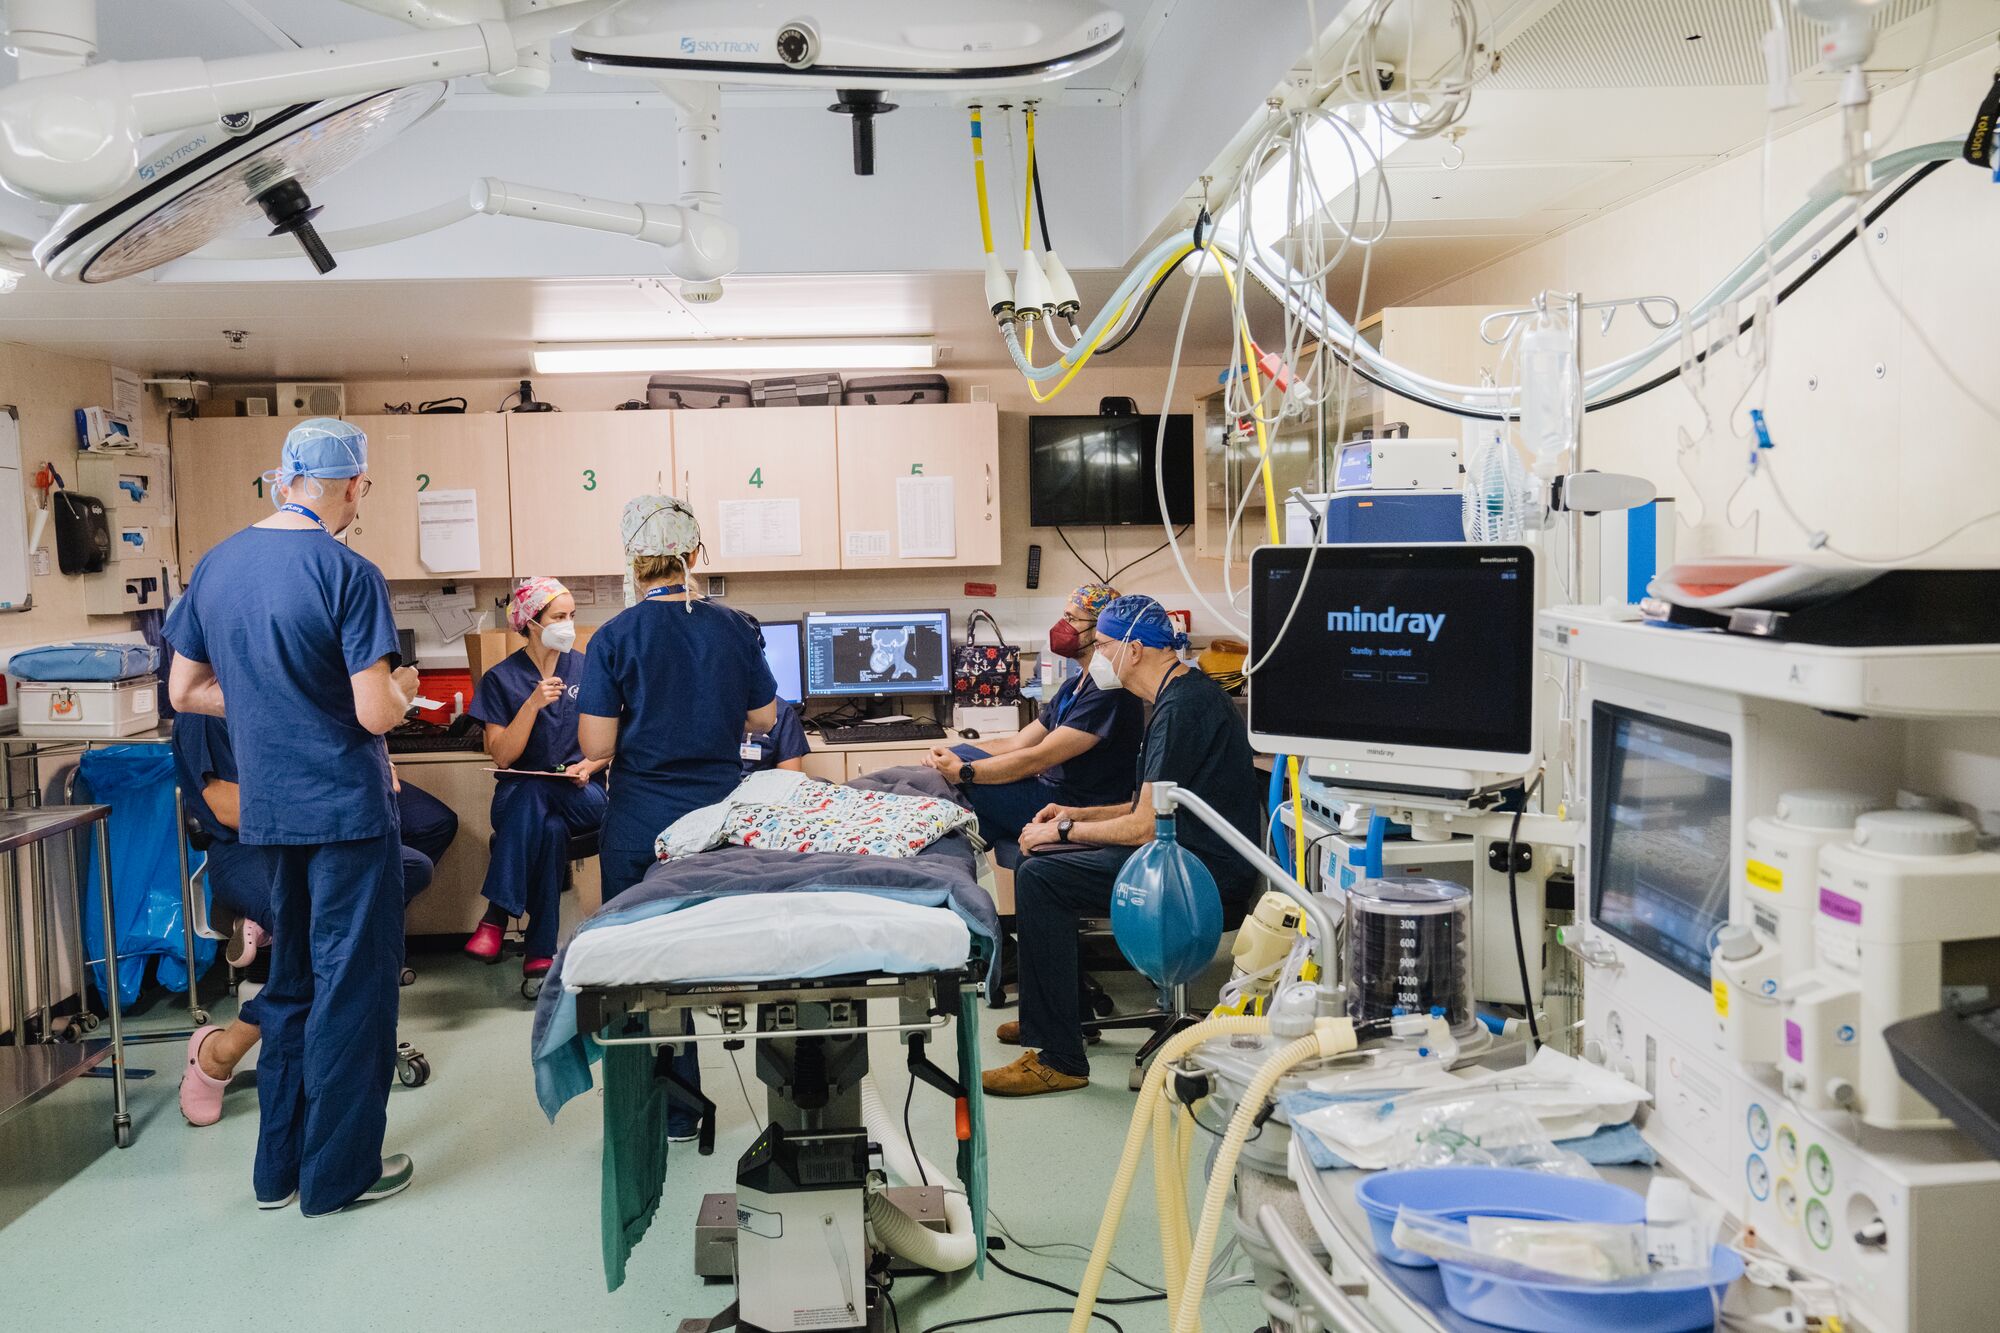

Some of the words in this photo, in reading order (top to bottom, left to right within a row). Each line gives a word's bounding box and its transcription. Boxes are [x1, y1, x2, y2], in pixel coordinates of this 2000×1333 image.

[698, 40, 760, 53] SKYTRON
[154, 135, 208, 171] SKYTRON
[416, 474, 430, 492] 2
[582, 469, 597, 491] 3
[748, 467, 764, 488] 4
[252, 476, 263, 498] 1
[1328, 606, 1446, 642] mindray
[1366, 748, 1395, 758] mindray
[1400, 919, 1416, 929] 300
[1400, 938, 1416, 948] 600
[1400, 957, 1416, 968] 900
[1398, 976, 1418, 986] 1200
[1398, 993, 1418, 1003] 1500
